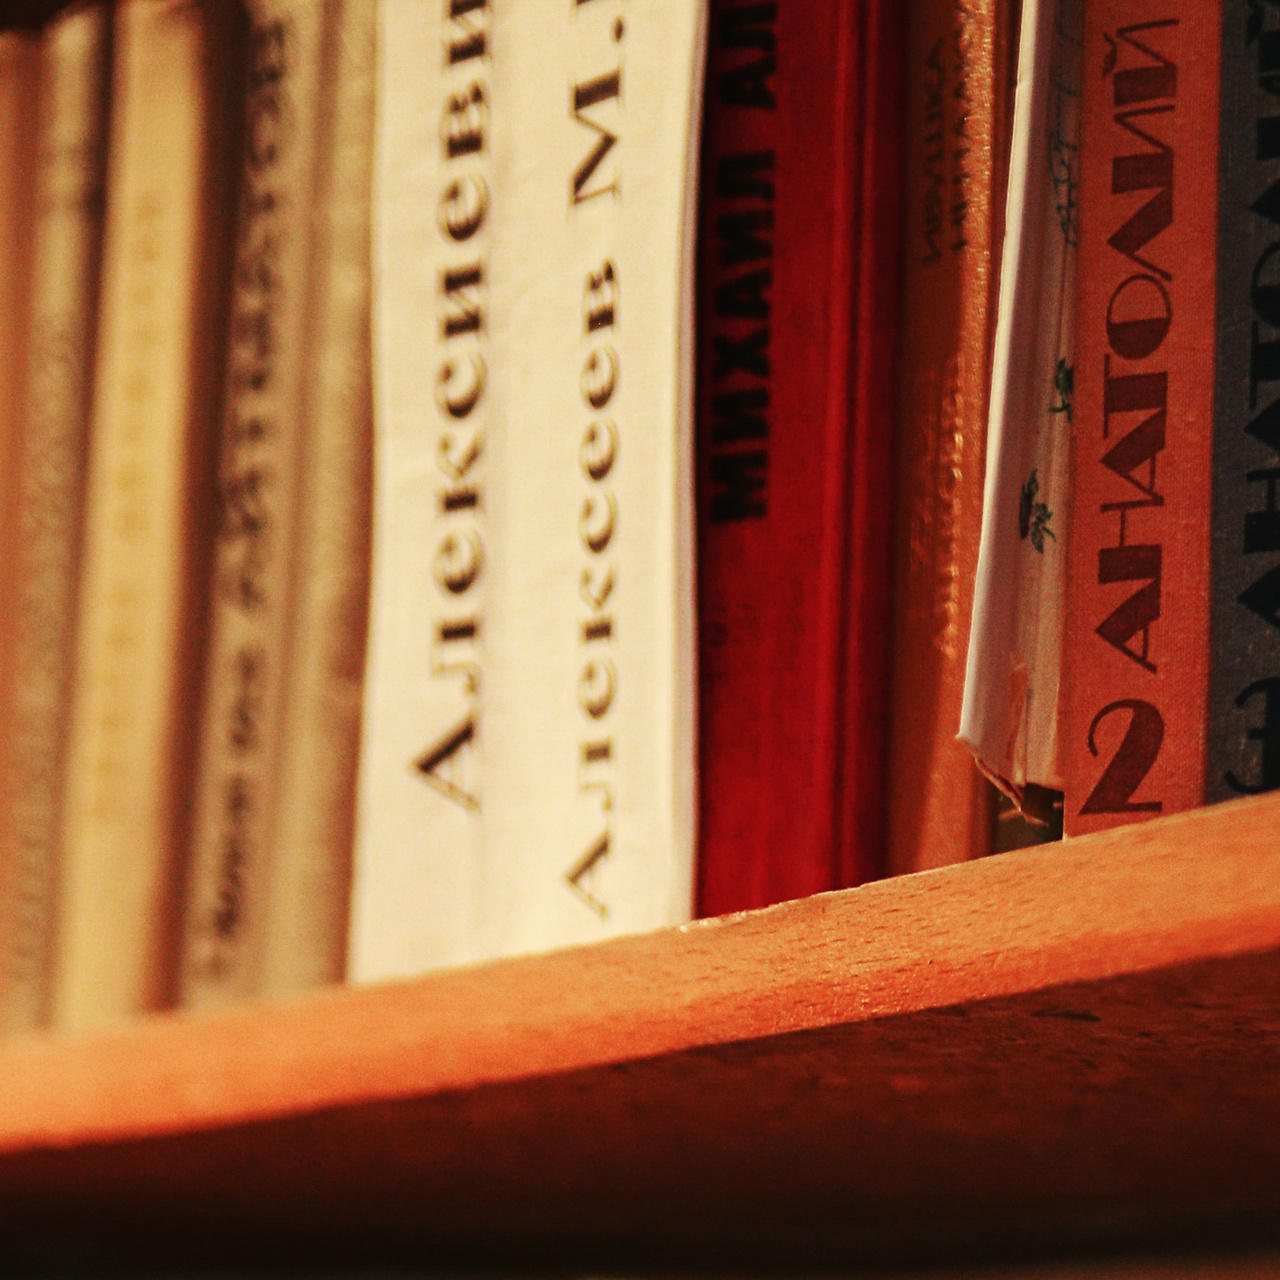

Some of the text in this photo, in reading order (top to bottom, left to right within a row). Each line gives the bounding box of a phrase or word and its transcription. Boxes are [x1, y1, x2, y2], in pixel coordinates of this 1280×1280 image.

[561, 0, 632, 919] Алексеев М.
[710, 151, 777, 523] МИХАИЛ
[1078, 18, 1181, 818] 2 АНАТОЛИЙ
